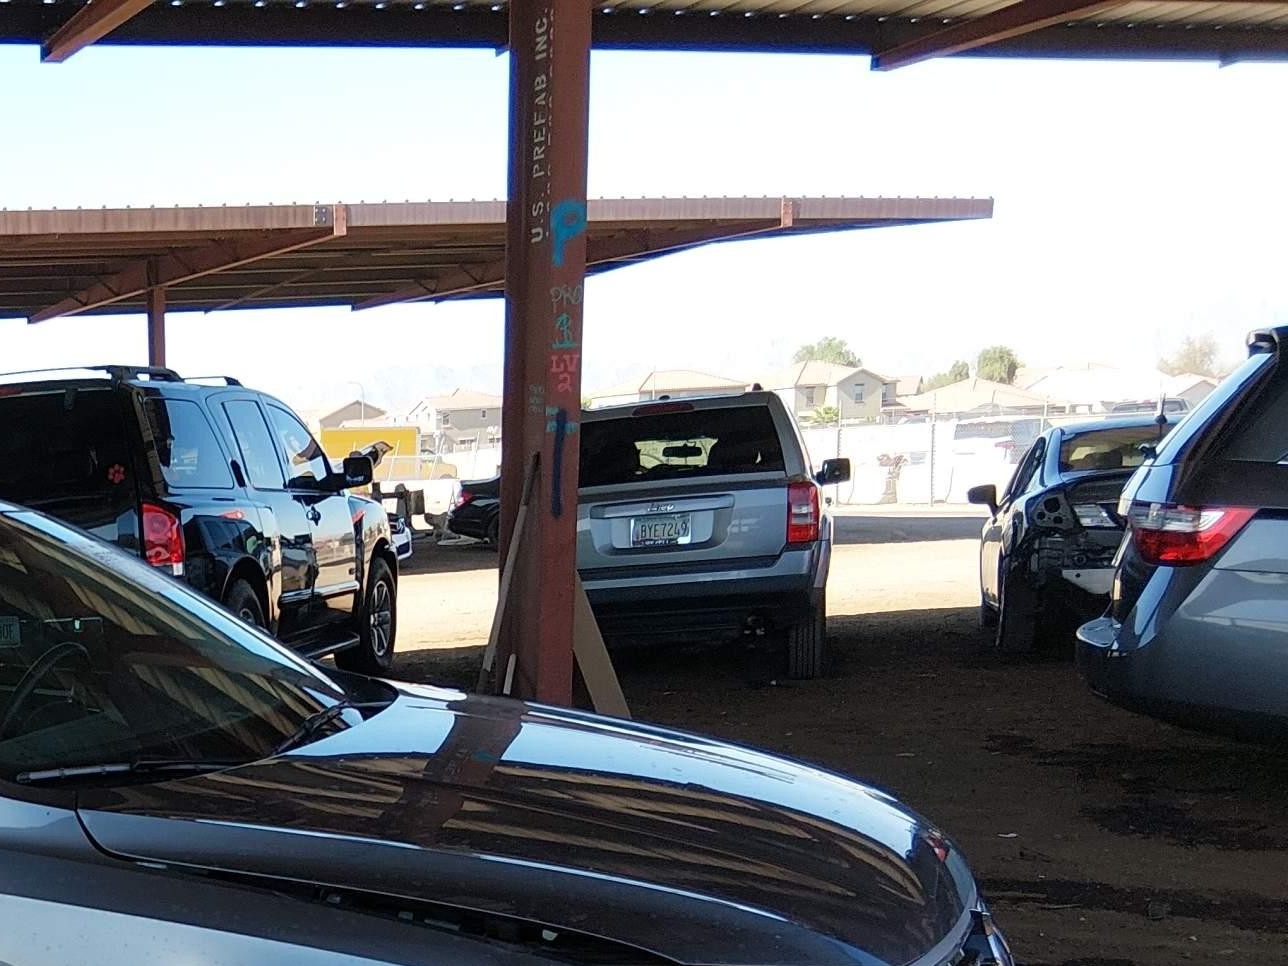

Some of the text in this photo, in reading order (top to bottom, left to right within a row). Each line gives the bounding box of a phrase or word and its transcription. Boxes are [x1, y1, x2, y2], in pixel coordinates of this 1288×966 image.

[531, 8, 548, 243] U.S. PREFAB INC.
[550, 199, 587, 265] P
